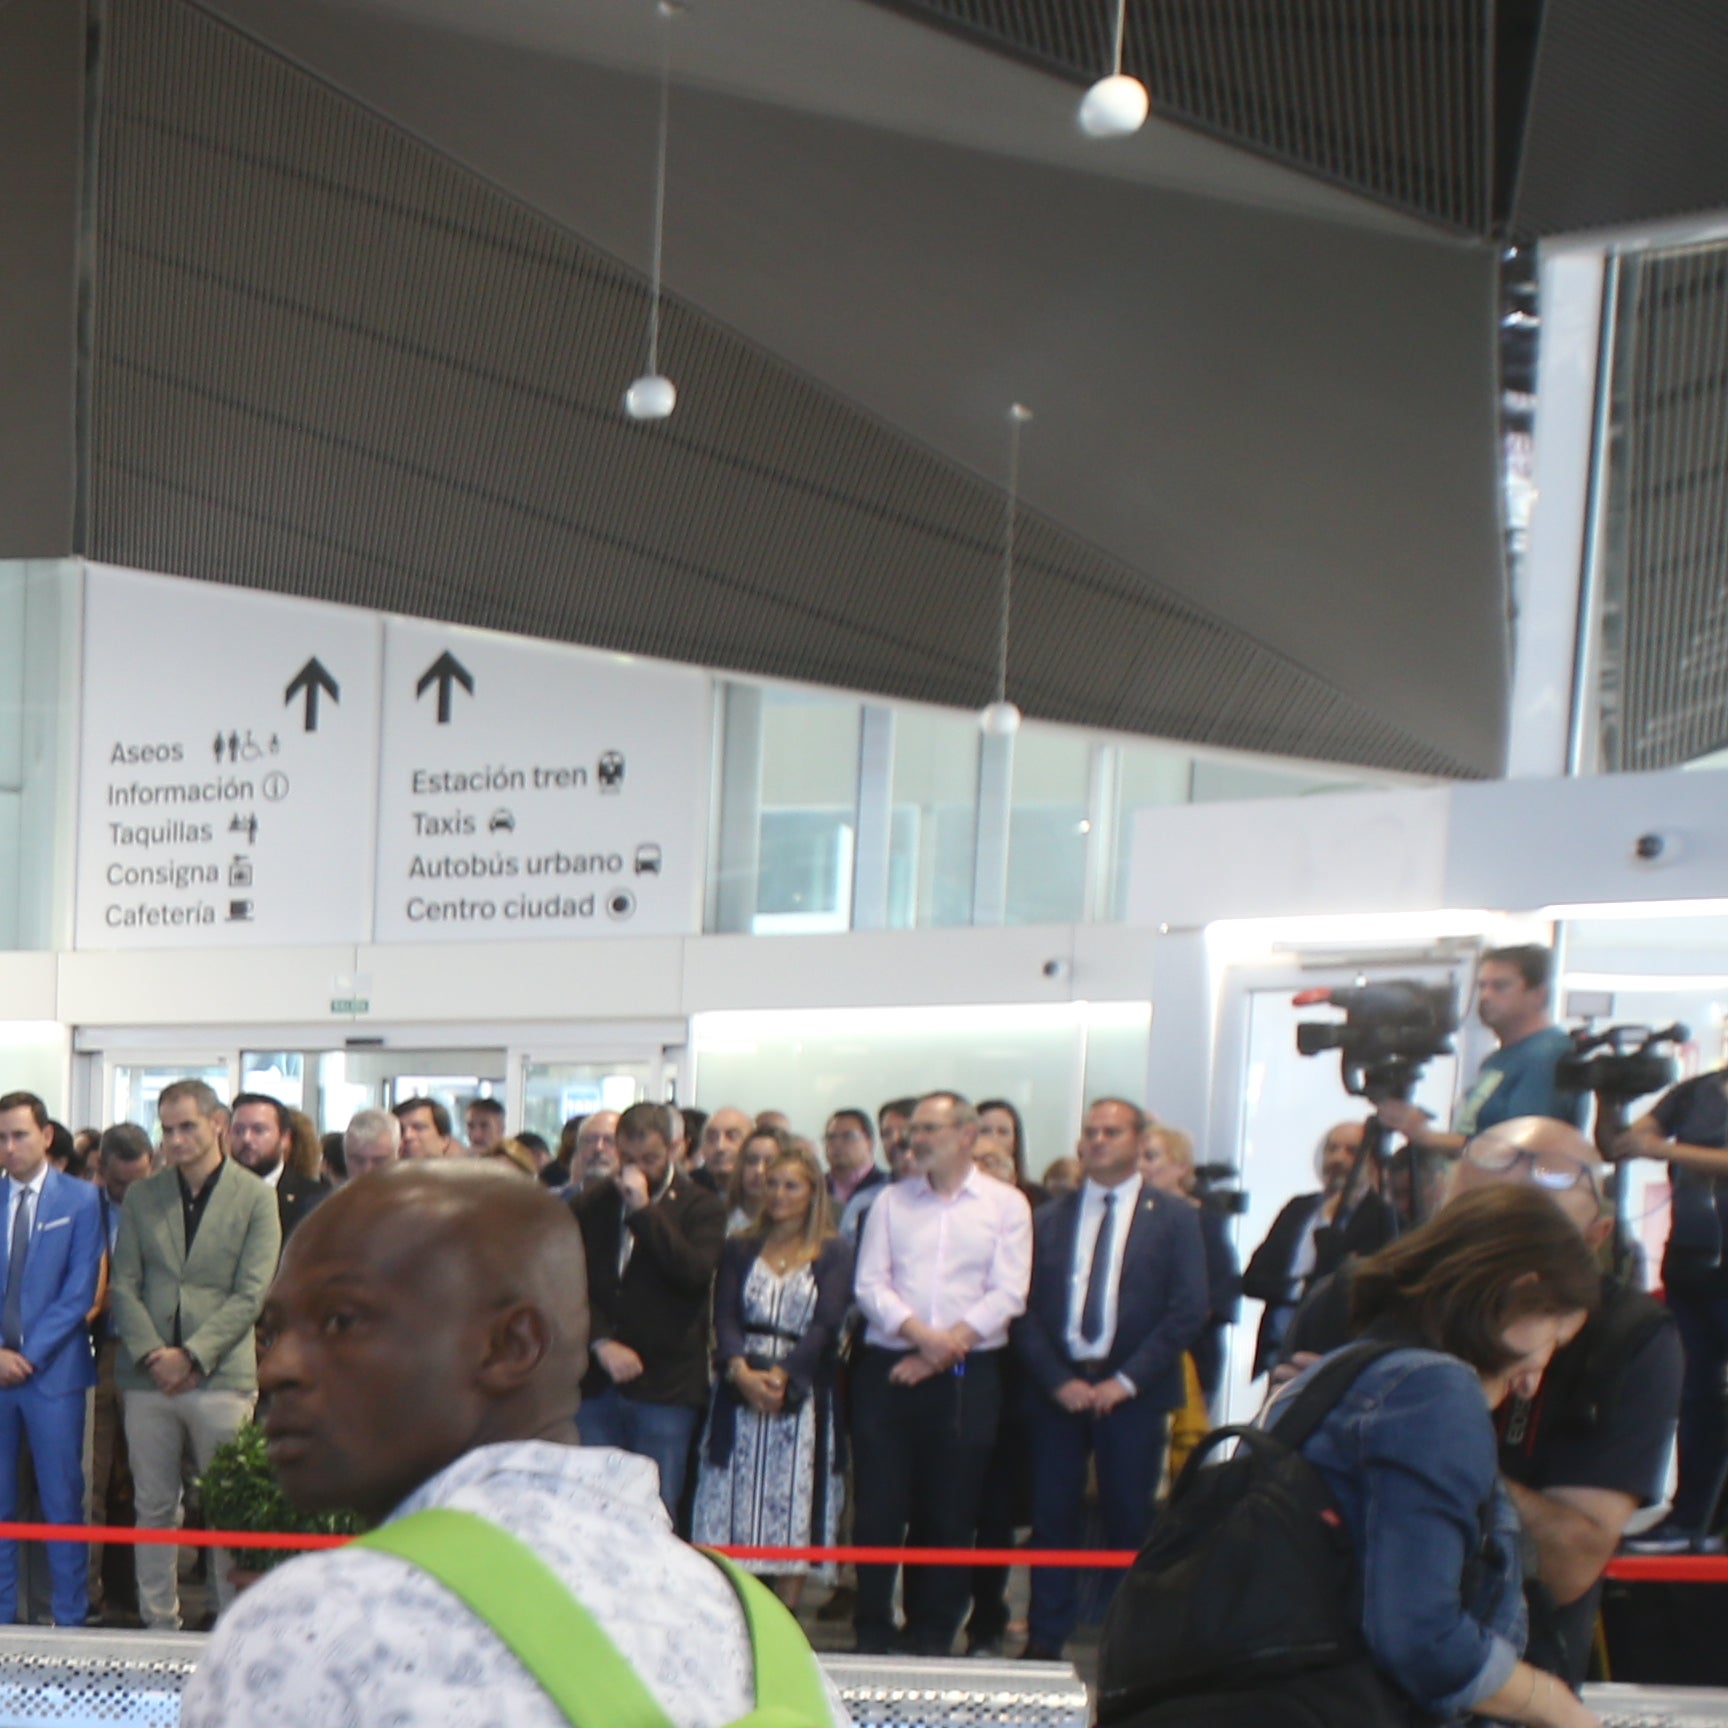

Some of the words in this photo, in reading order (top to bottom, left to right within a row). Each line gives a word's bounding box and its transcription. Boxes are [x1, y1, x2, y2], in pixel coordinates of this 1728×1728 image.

[110, 741, 184, 765] Aseos
[107, 776, 255, 806] Información
[411, 765, 525, 794] Estación
[533, 766, 588, 788] tren
[108, 819, 214, 848] Taquillas
[411, 808, 476, 836] Taxis
[106, 860, 220, 889] Consigna
[409, 852, 519, 879] Autobús
[526, 851, 624, 875] urbano
[105, 900, 216, 927] Cafetería
[406, 896, 497, 922] Centro
[503, 893, 596, 920] ciudad
